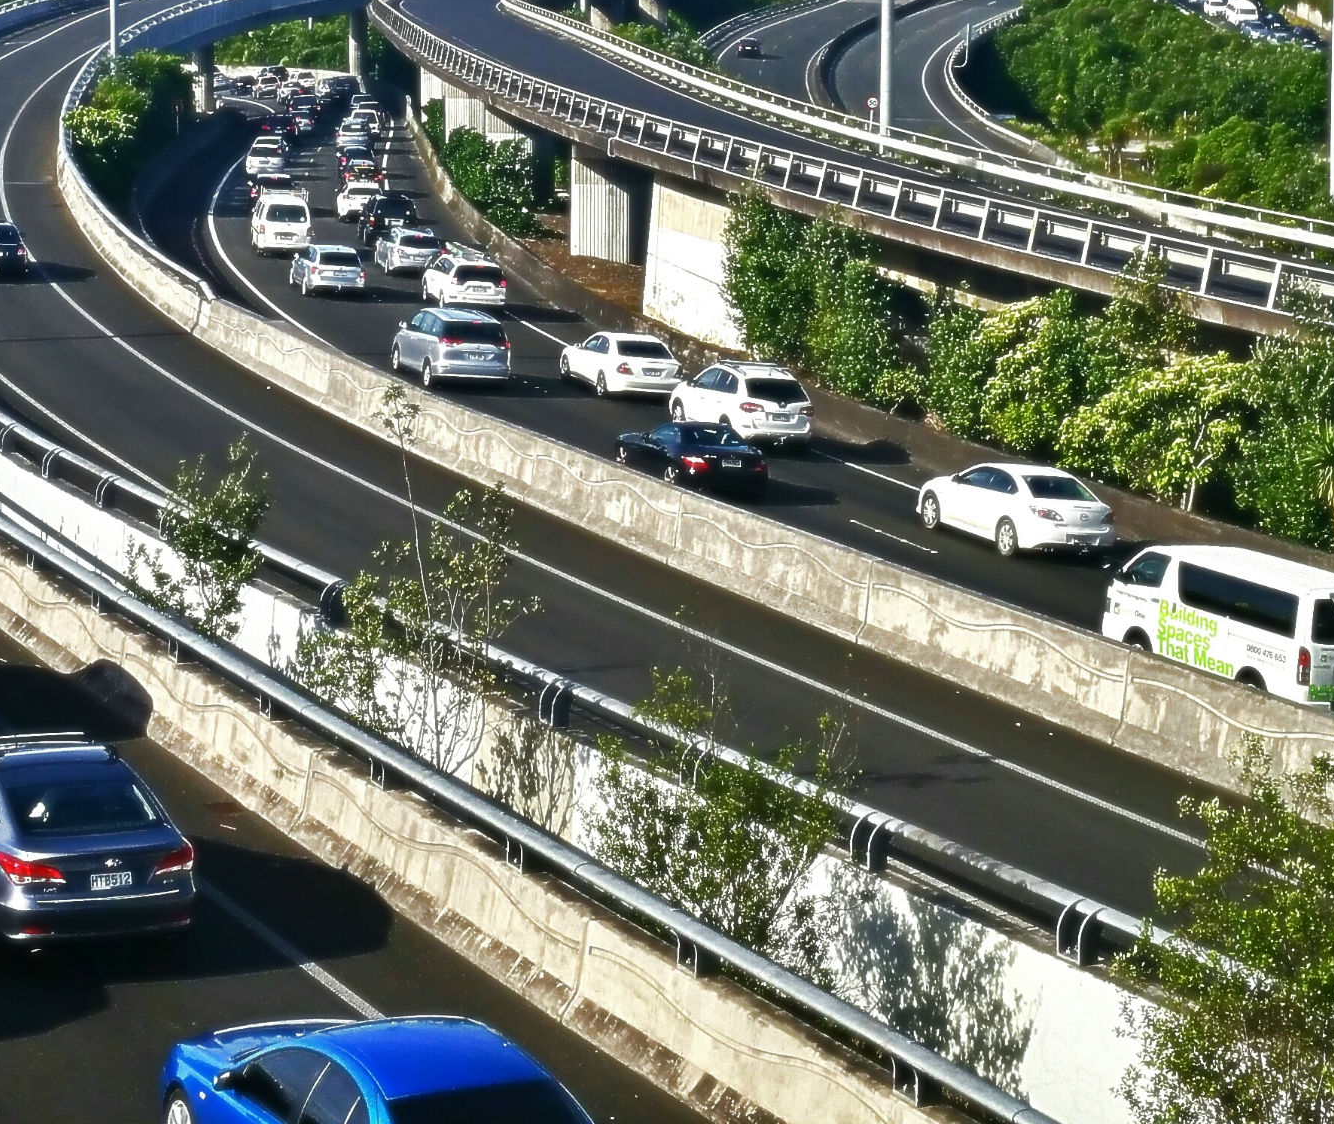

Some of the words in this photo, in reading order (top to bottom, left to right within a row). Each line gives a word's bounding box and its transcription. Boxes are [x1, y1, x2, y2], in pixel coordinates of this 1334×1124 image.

[1157, 617, 1211, 651] Spaces
[1160, 598, 1218, 637] Building
[1157, 634, 1189, 664] That
[1193, 647, 1234, 678] Mean
[1246, 643, 1262, 656] 0800
[91, 872, 132, 890] HTB512
